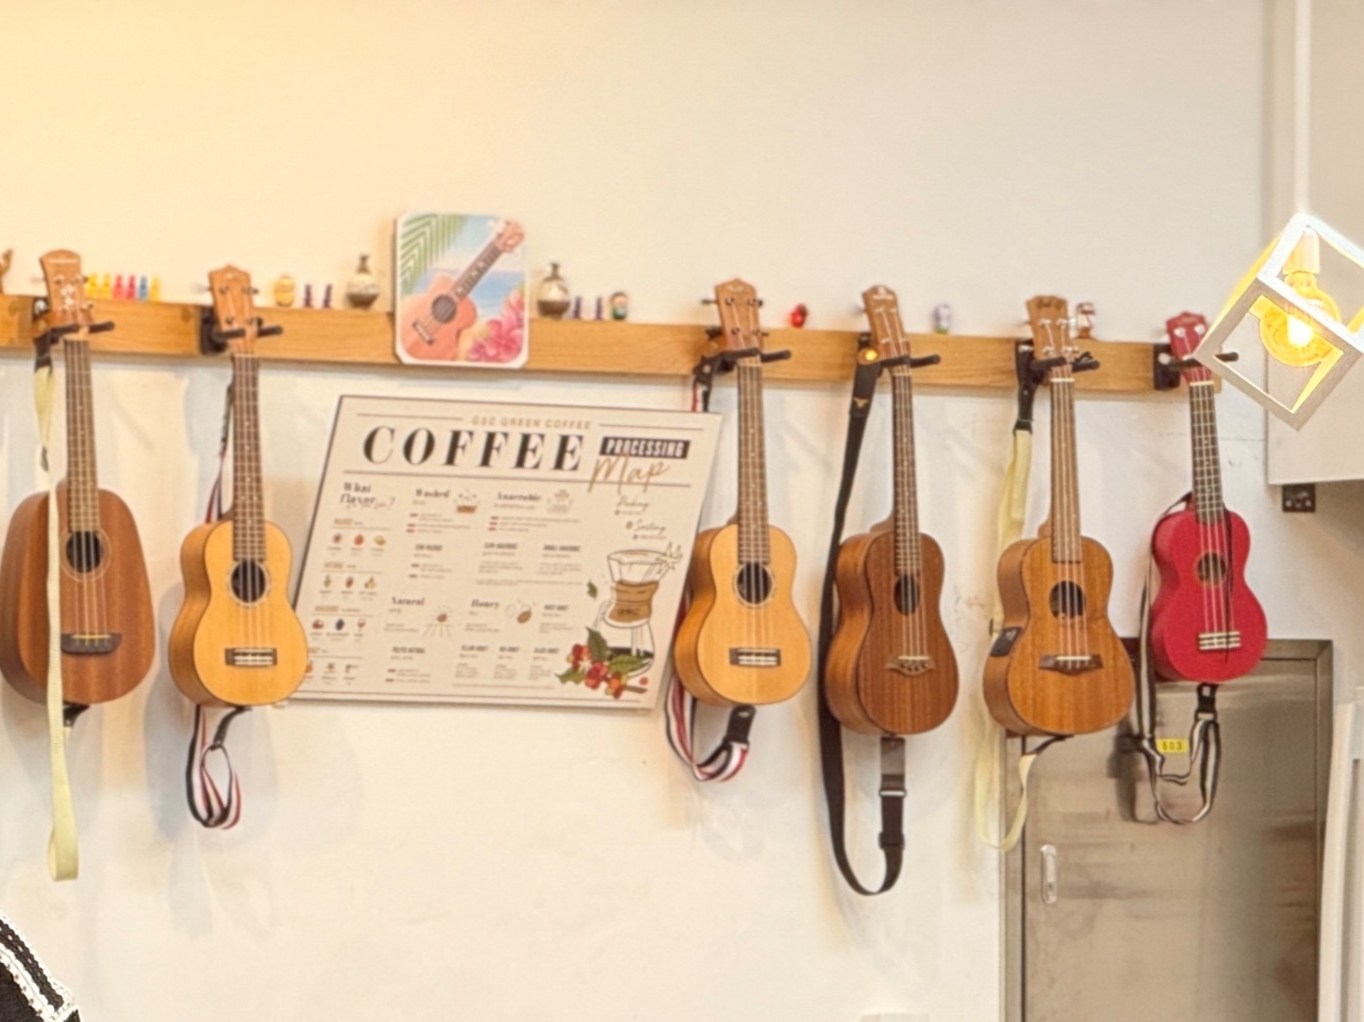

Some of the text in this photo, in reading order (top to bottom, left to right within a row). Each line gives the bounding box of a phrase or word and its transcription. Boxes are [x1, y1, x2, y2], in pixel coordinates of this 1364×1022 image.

[500, 417, 541, 428] GREEN
[544, 419, 591, 430] COFFEE
[363, 425, 584, 472] COFFEE
[604, 438, 686, 458] PROCESSING
[587, 454, 670, 496] Map
